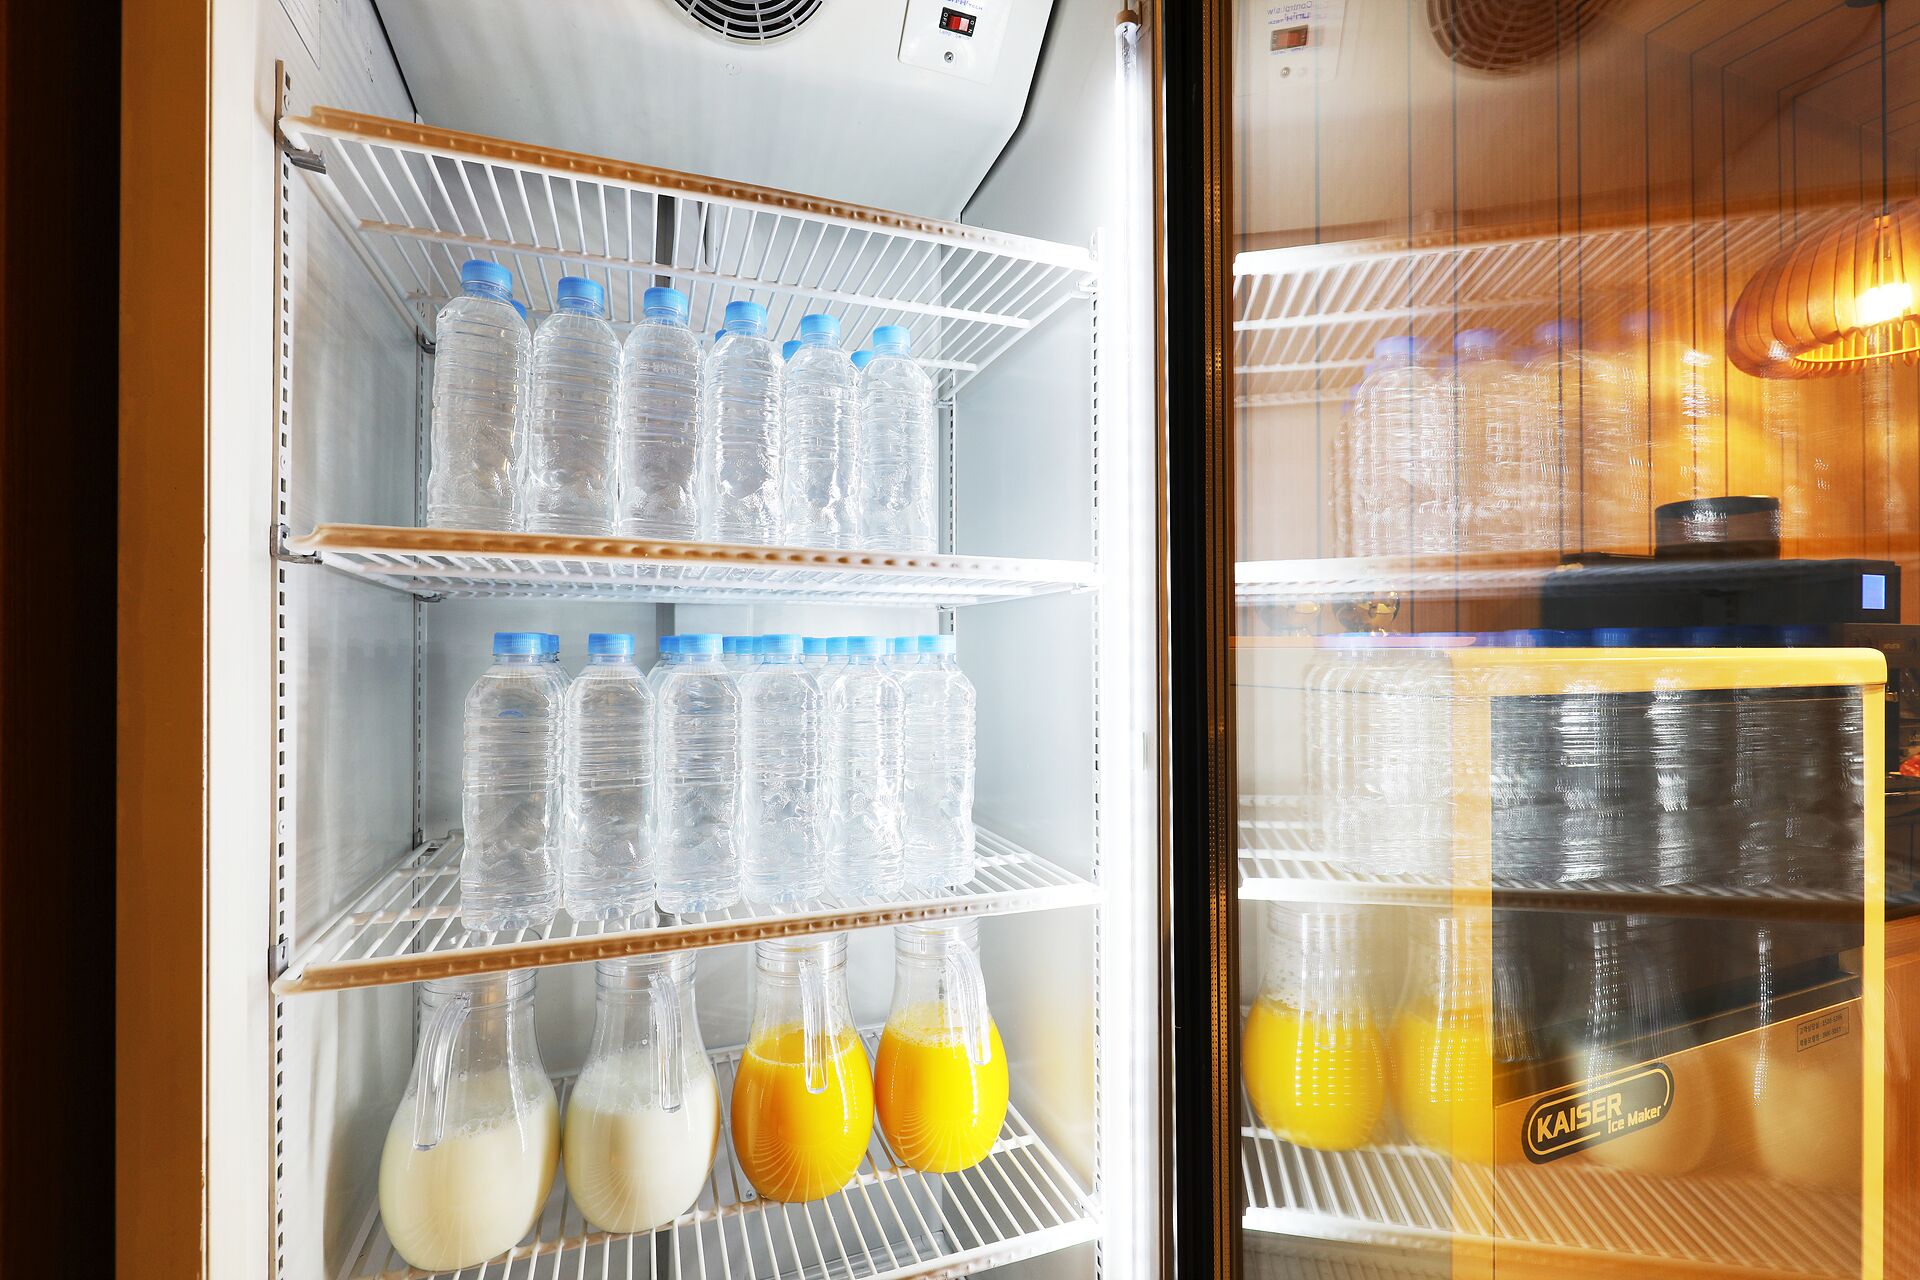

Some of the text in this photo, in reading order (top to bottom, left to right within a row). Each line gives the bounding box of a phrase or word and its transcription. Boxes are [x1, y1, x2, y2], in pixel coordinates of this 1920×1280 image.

[1537, 1093, 1622, 1143] KAISER
[1608, 1106, 1662, 1134] Ice Maker
